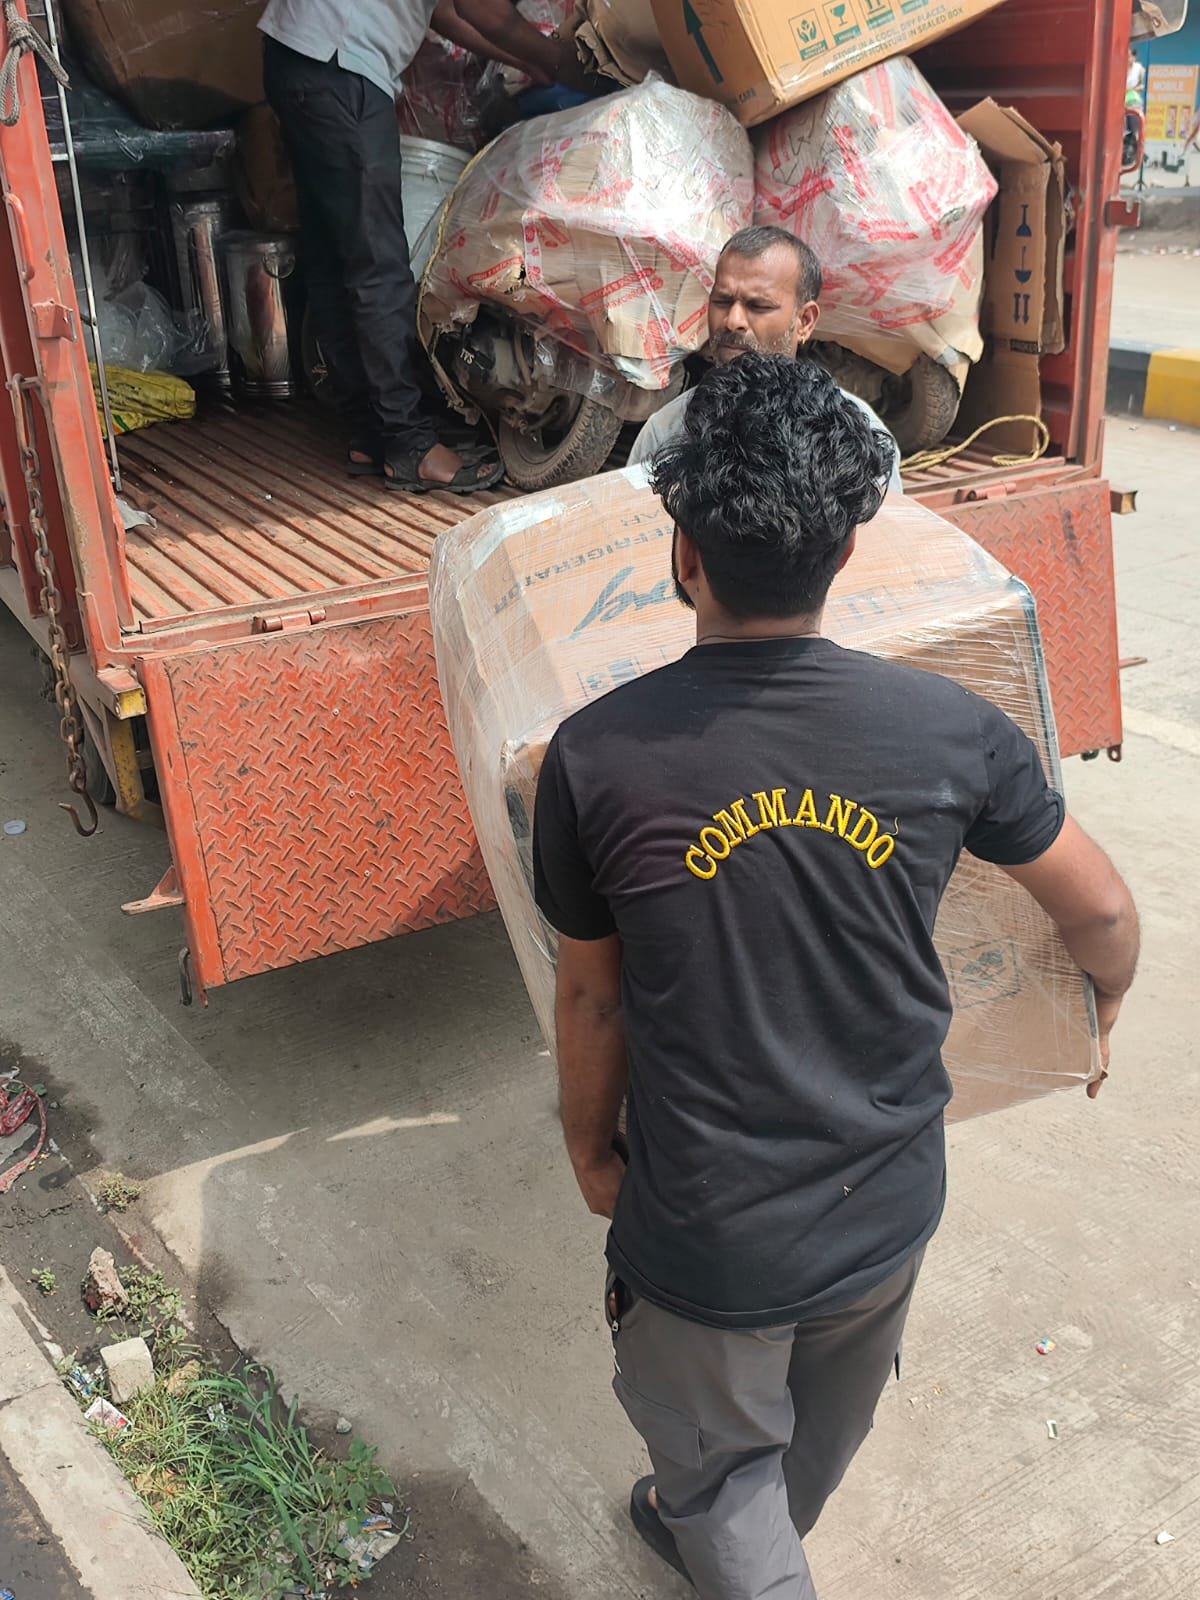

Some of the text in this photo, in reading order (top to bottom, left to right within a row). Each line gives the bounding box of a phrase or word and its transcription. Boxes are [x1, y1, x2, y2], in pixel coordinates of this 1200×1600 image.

[845, 49, 868, 65] FROM
[868, 31, 907, 57] MOISTURE
[917, 14, 946, 33] SEALED
[947, 7, 963, 20] BOX
[460, 347, 475, 365] TVS
[685, 787, 896, 881] COMMANDO
